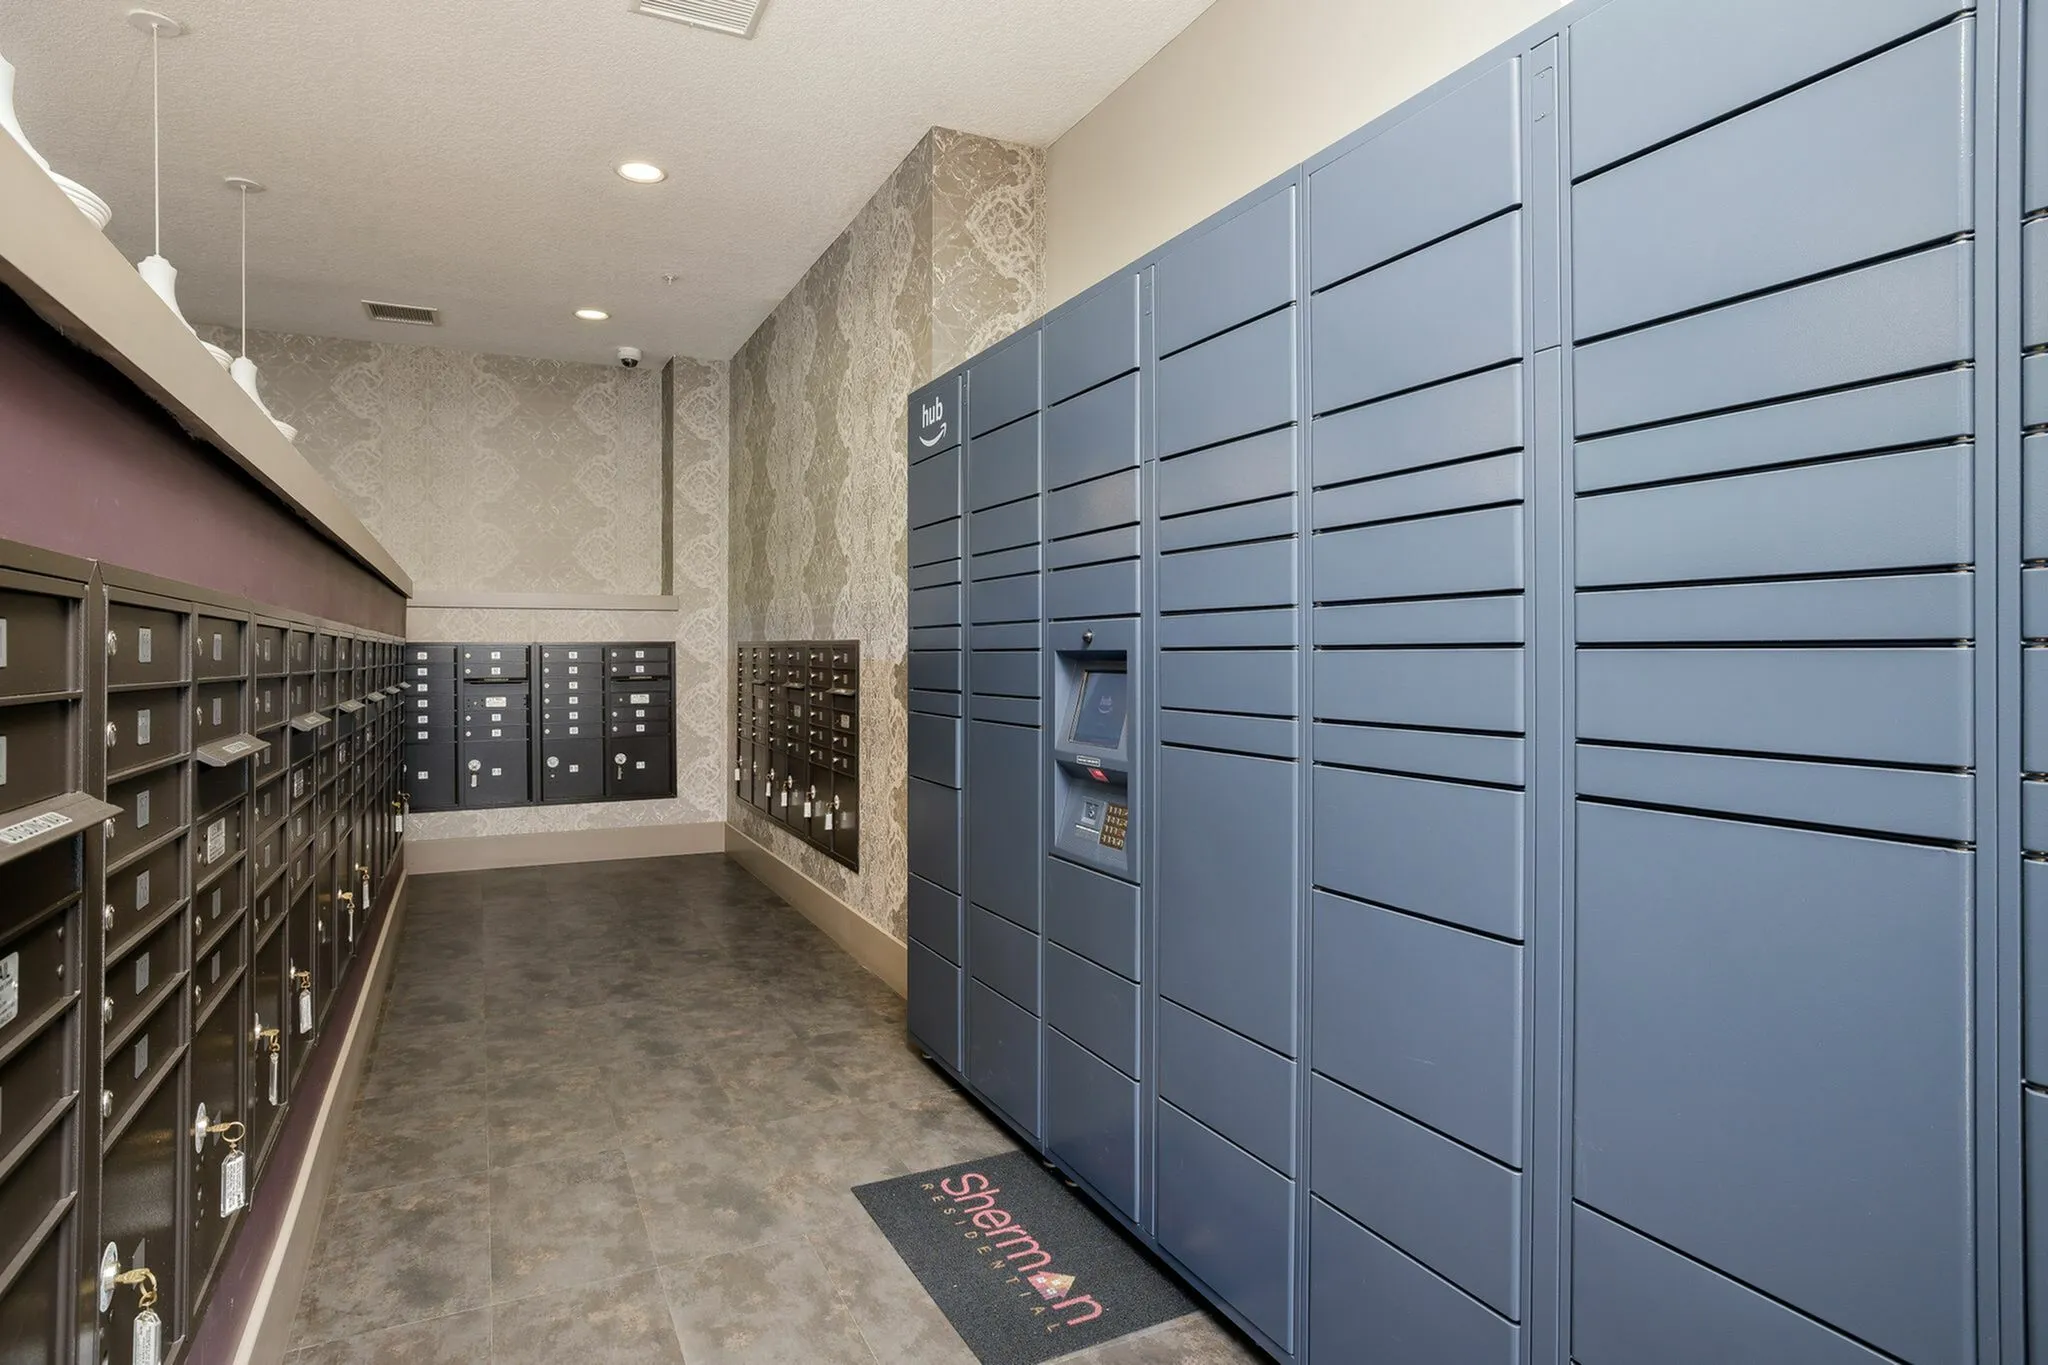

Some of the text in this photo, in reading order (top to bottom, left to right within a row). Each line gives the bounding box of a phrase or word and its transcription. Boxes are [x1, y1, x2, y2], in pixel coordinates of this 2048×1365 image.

[922, 396, 943, 428] hub
[920, 1182, 1060, 1333] RESIDENTIAL
[940, 1172, 1103, 1327] Shermn
